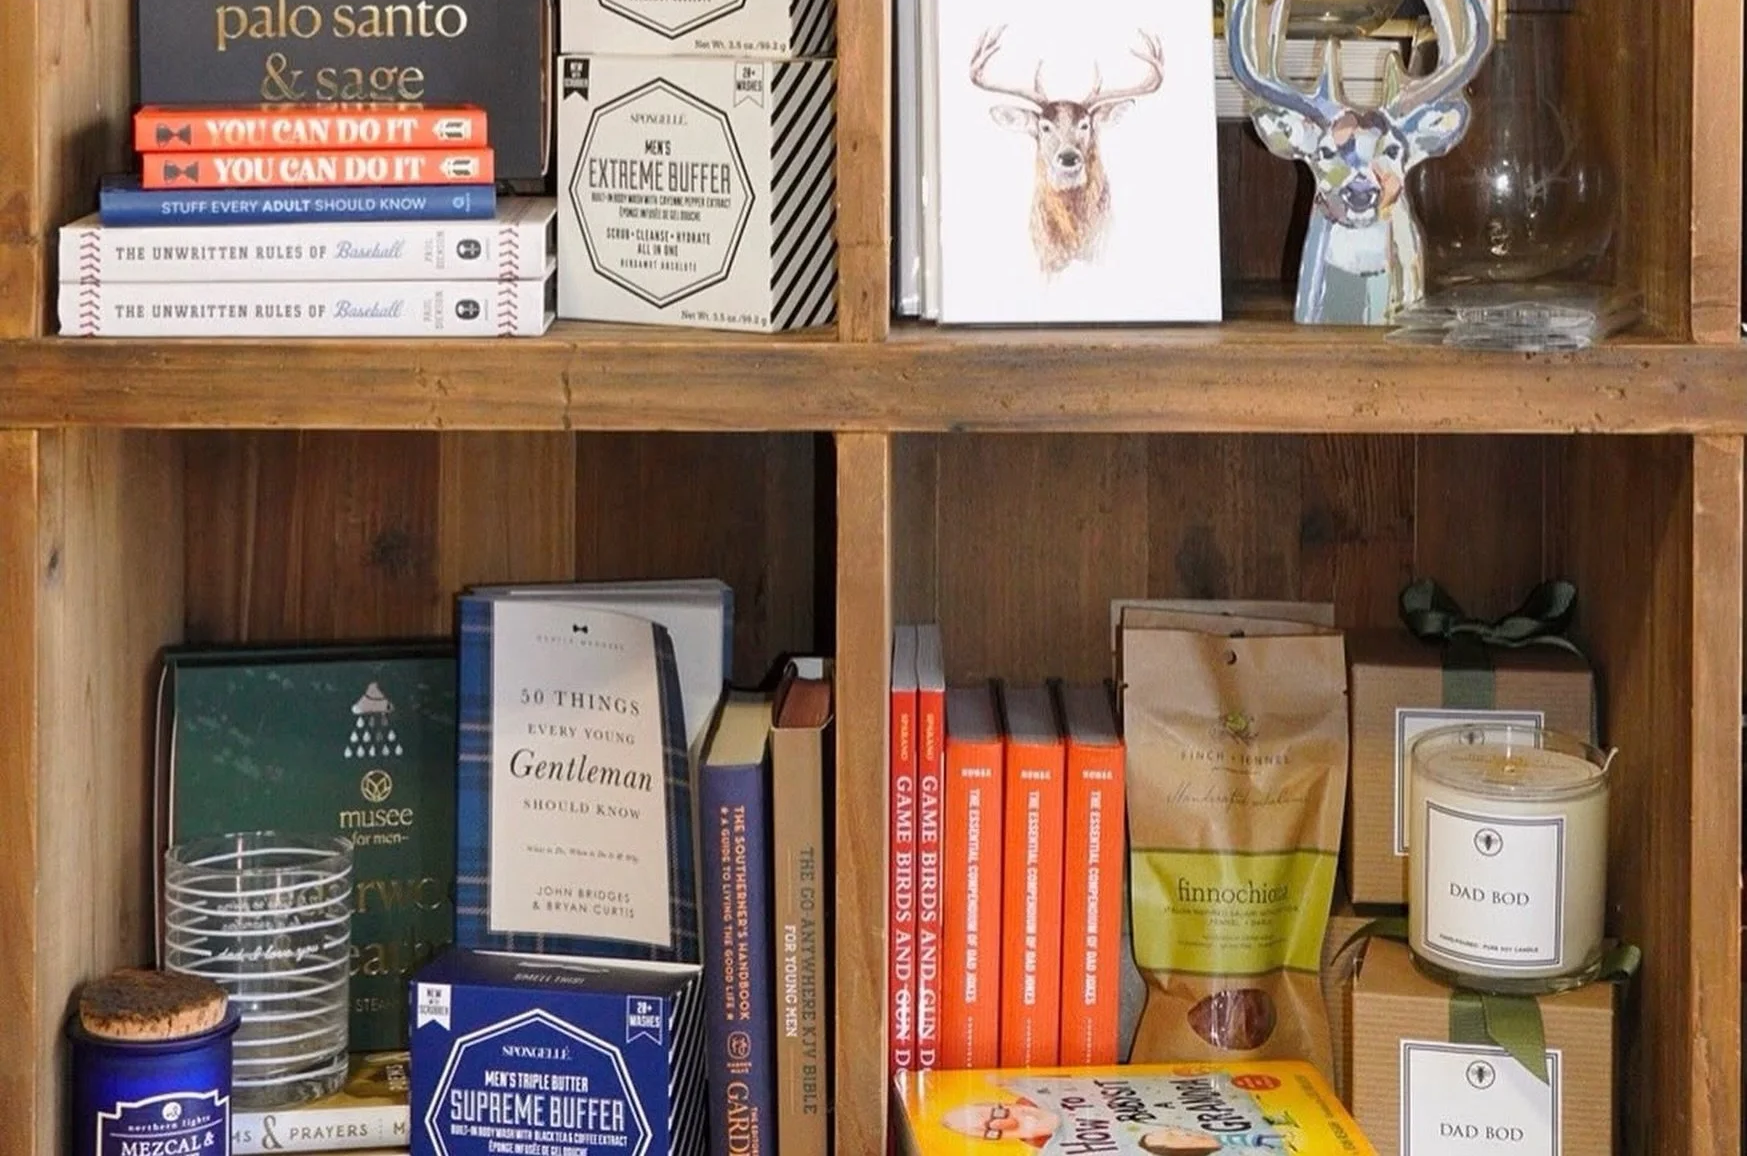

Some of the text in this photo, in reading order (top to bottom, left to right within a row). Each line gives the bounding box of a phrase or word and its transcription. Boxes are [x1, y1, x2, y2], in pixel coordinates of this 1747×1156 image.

[333, 0, 467, 38] santo
[261, 52, 425, 103] & sage
[205, 118, 418, 144] YOU CAN DO IT
[644, 140, 671, 155] MEN'S
[213, 156, 425, 183] YOU CAN DO IT
[588, 158, 731, 194] EXTREME BUFFER
[161, 198, 426, 214] STUFF EVERY ADULT SHOULD KNOW
[606, 227, 711, 245] SCRUB CLEANSE HYDRATE
[116, 239, 405, 260] THE UNWRITTEN RULES OF Baseball
[637, 243, 678, 257] ALL IN ONE
[115, 299, 405, 318] THE UNWRITTEN RULES OF Baseball
[521, 688, 641, 715] 50 THINGS
[528, 723, 636, 745] EVERY YOUNG
[509, 748, 654, 792] Gentleman
[340, 807, 413, 829] musee
[523, 799, 642, 820] SHOULD KNOW
[896, 776, 912, 843] GAME
[921, 776, 938, 843] GAME
[722, 866, 731, 881] TO
[537, 886, 631, 904] JOHN BRIDGES
[895, 852, 912, 922] BIRDS
[921, 852, 937, 922] BIRDS
[1450, 883, 1530, 906] DAD BOD
[532, 901, 635, 919] & BRYAN CURTIS
[722, 884, 732, 922] LIVING
[734, 806, 750, 1020] THE SOUTHERNER'S HANDBOOK
[723, 925, 733, 946] THE
[725, 950, 734, 983] GOOD
[895, 931, 911, 980] AND
[920, 931, 936, 980] AND
[784, 925, 798, 1037] FOR YOUNG MEN
[800, 847, 817, 1115] THE GO-ANYWHERE KJV BIBLE
[726, 986, 735, 1009] LIFE
[629, 1015, 661, 1028] WASHES
[485, 1071, 588, 1092] MEN'S TRIPLE BUTTER
[450, 1090, 624, 1133] SUPREME BUFFER
[1154, 1101, 1176, 1110] A
[128, 1114, 211, 1133] northern lights
[262, 1115, 368, 1149] & PRAYERS
[1440, 1123, 1524, 1141] DAD BOD
[121, 1132, 214, 1156] MEZCAL &
